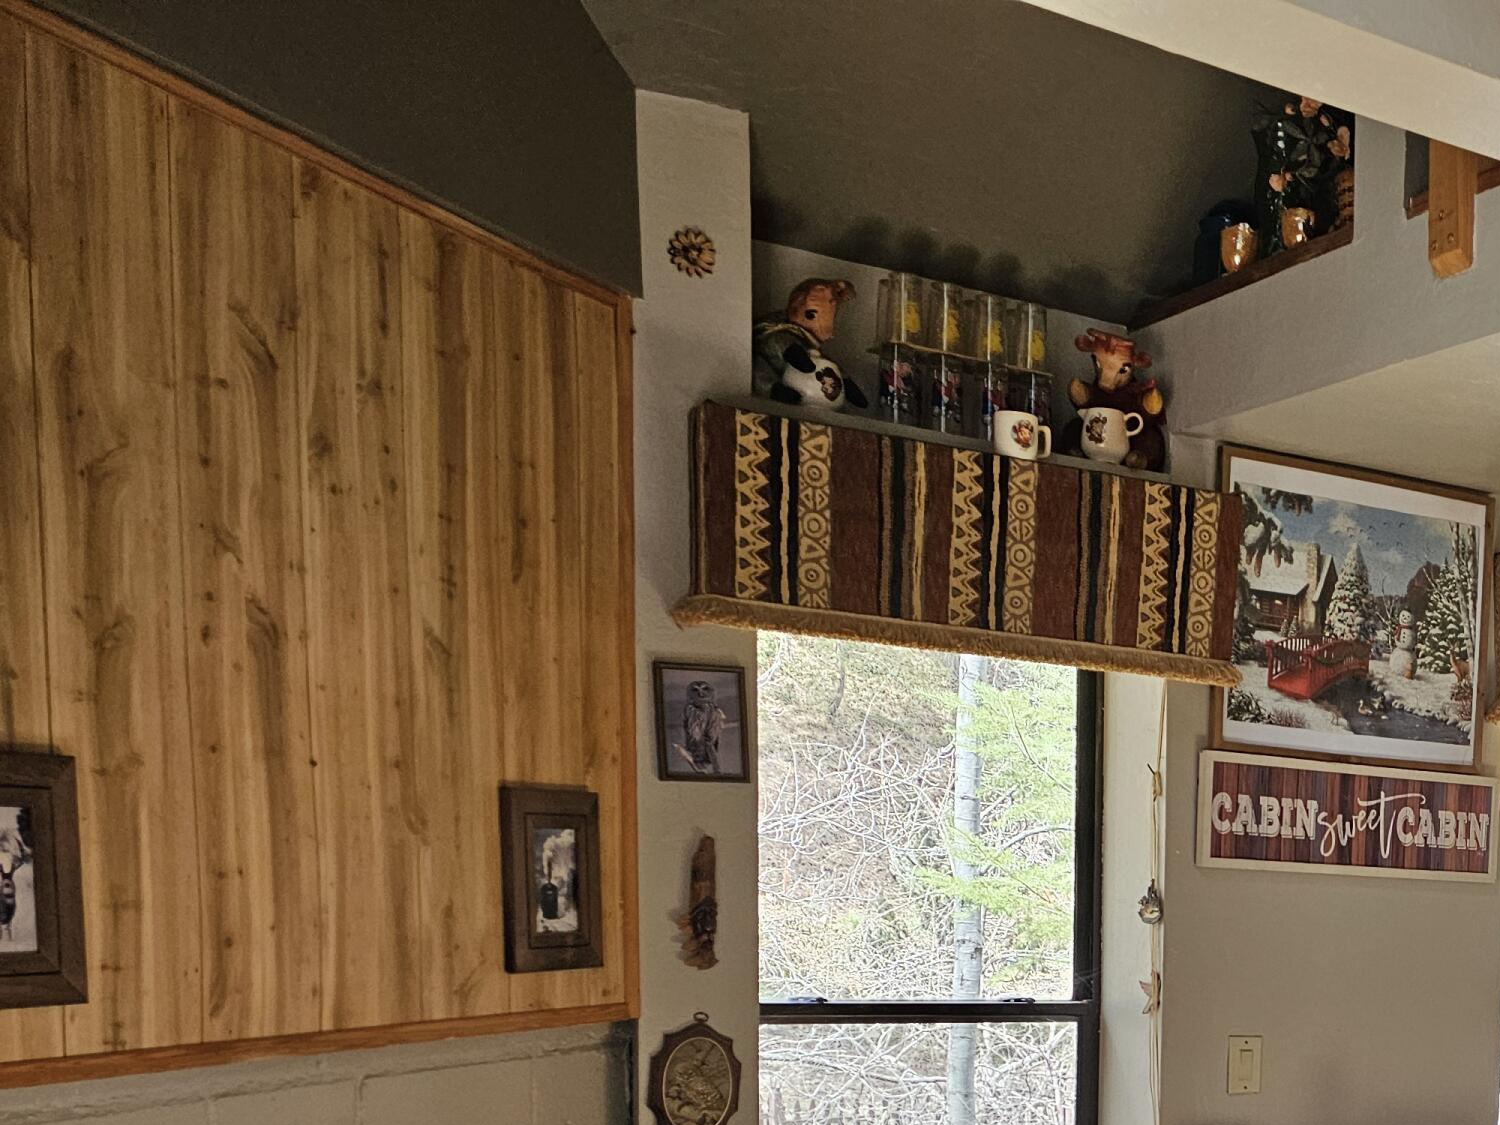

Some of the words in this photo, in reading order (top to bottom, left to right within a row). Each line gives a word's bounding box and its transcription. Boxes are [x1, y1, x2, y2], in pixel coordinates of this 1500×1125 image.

[1211, 792, 1319, 840] CABIN
[1317, 791, 1426, 859] sweet
[1396, 806, 1490, 851] CABIN
